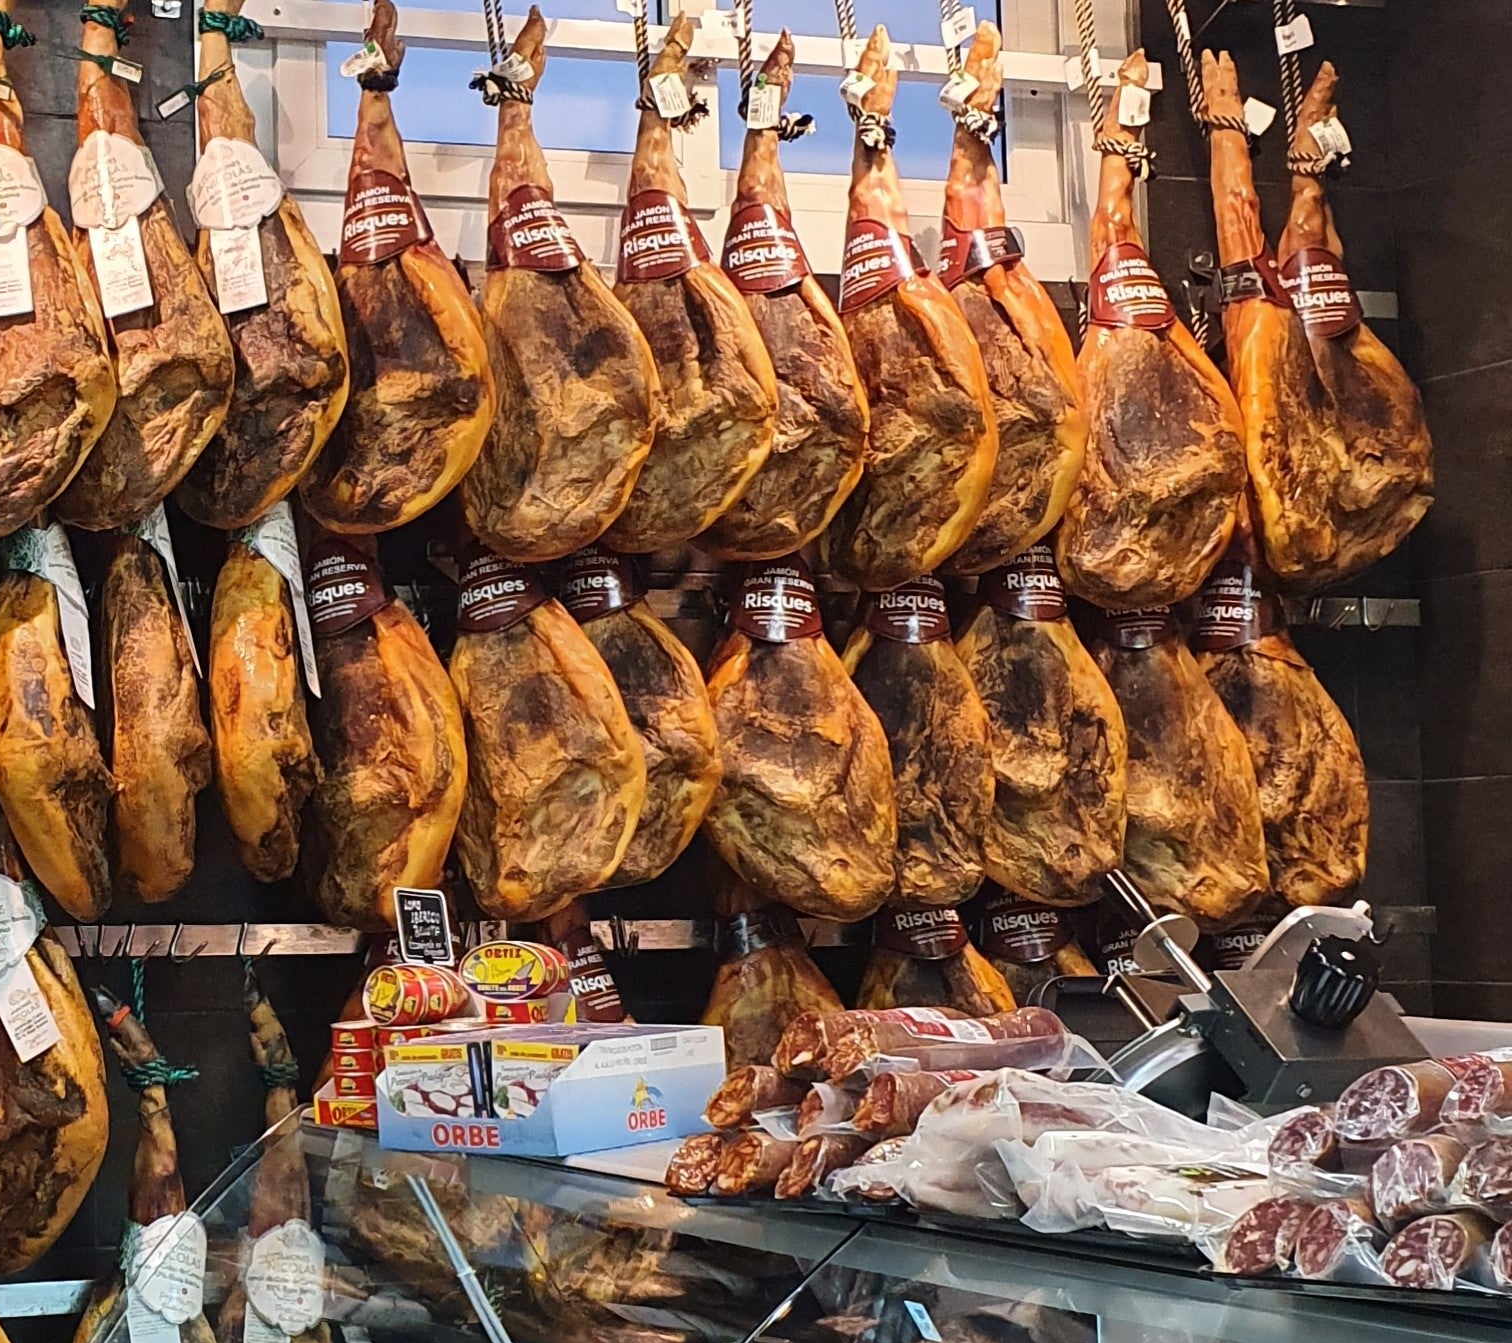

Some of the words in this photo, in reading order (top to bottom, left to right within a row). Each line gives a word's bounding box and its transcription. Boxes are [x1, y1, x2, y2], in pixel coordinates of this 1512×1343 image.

[344, 212, 409, 241] Risques
[321, 564, 368, 578] RESERVA
[1007, 572, 1060, 591] Risque
[461, 579, 526, 607] Risques
[745, 592, 813, 613] Risques
[880, 592, 945, 612] Risques
[894, 907, 960, 932] Risques
[991, 910, 1060, 933] Risques
[627, 1109, 667, 1132] ORBE
[431, 1122, 501, 1149] ORBE
